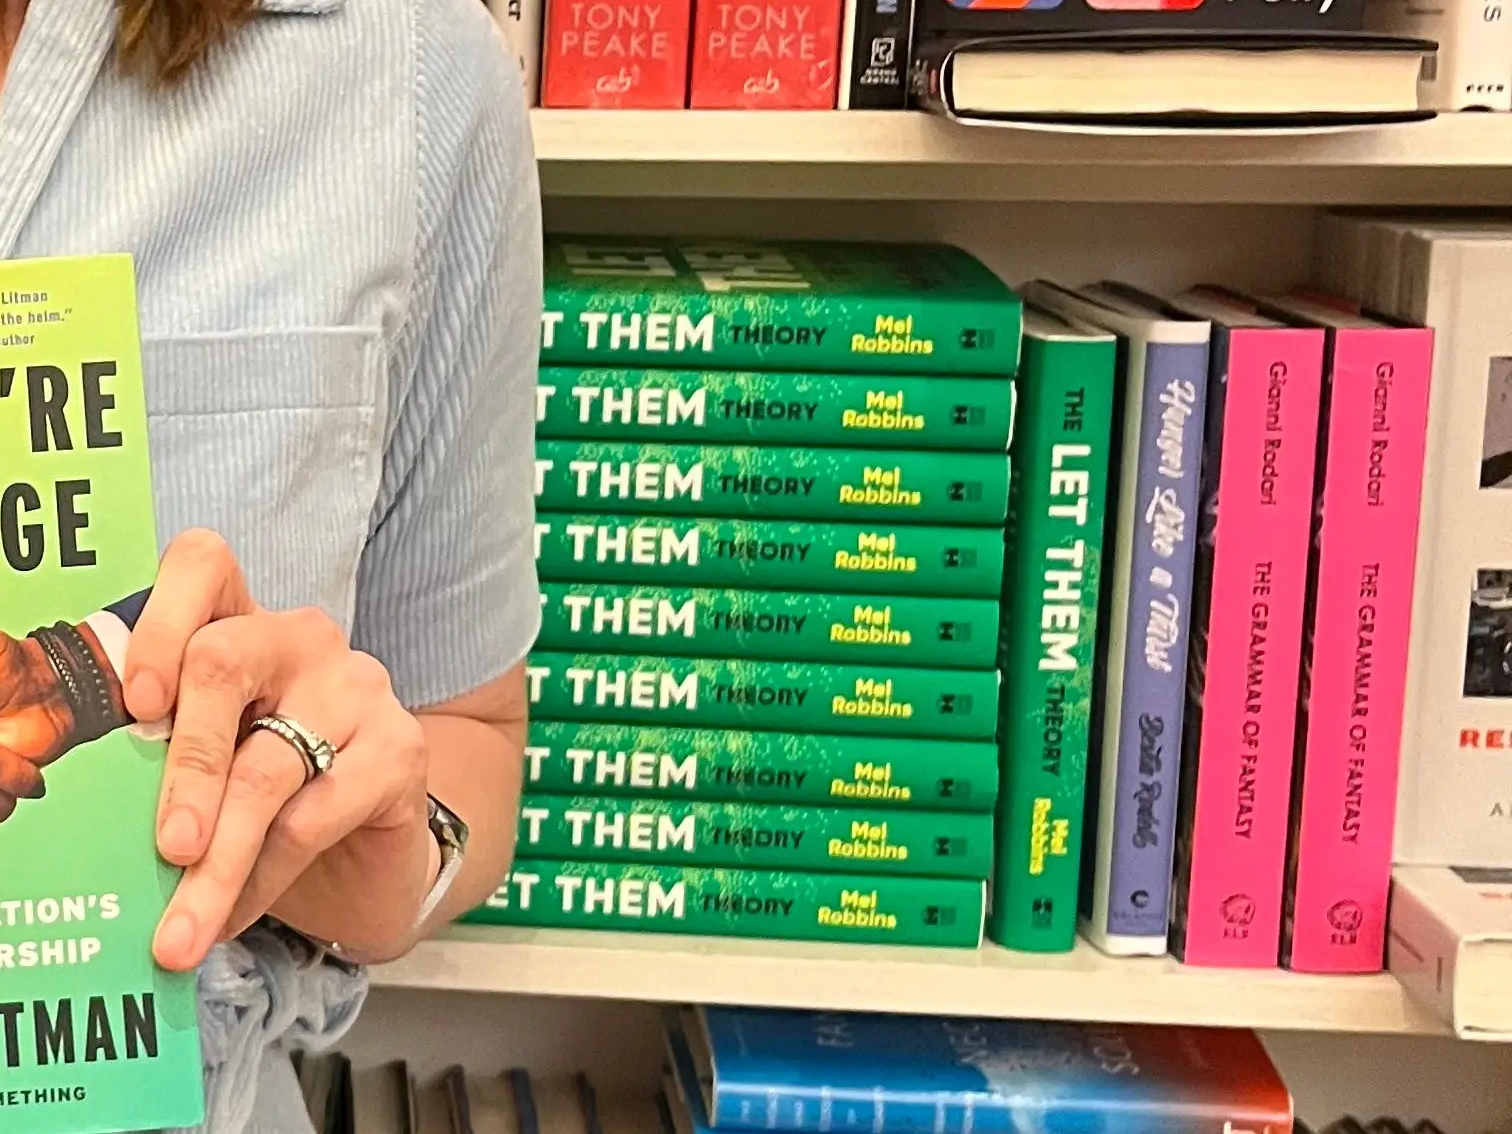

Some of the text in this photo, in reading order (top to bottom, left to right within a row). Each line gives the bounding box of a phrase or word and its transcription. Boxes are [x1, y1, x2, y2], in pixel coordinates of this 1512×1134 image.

[570, 2, 662, 32] TONY
[561, 30, 668, 59] PEAKE
[1, 291, 48, 306] Litman
[1, 312, 23, 325] the
[579, 311, 827, 353] THEM THEORY
[875, 314, 912, 336] Mel
[851, 333, 934, 356] Robbins
[1039, 387, 1091, 777] THE LET THEM THEORY
[1235, 360, 1288, 840] Gianni Rodari THE GRAMMAR OF FANTASY
